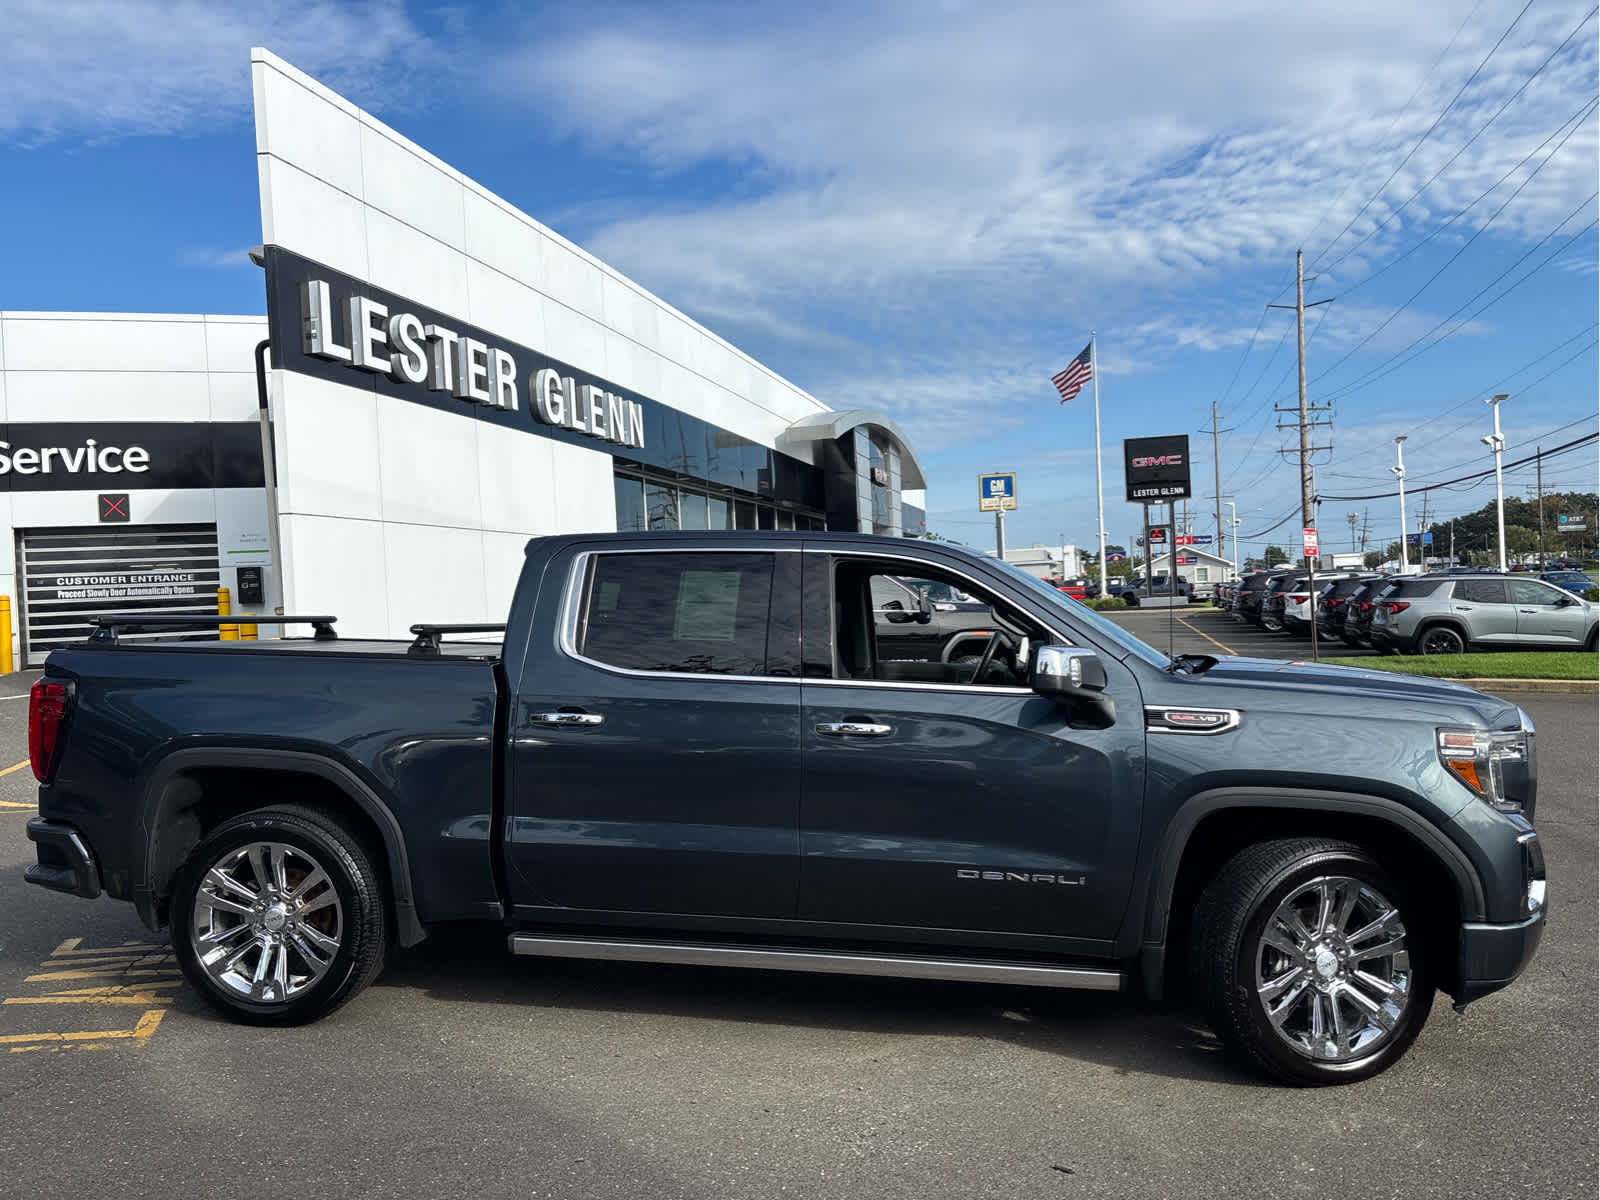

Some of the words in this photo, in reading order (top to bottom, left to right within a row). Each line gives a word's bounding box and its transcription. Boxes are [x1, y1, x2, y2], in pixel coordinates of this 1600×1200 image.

[307, 279, 519, 411] LESTER
[533, 368, 645, 449] GLENN
[1132, 455, 1182, 468] GMC
[1133, 488, 1160, 497] LESTER
[1161, 487, 1184, 495] GLENN
[56, 575, 127, 586] CUSTOMER
[130, 573, 195, 584] ENTRANCE
[57, 589, 86, 599] Proceed
[87, 588, 110, 598] Slowly
[110, 587, 126, 597] Door
[127, 586, 173, 596] Automatically
[173, 586, 195, 595] Opens
[957, 869, 1086, 885] DENALI
